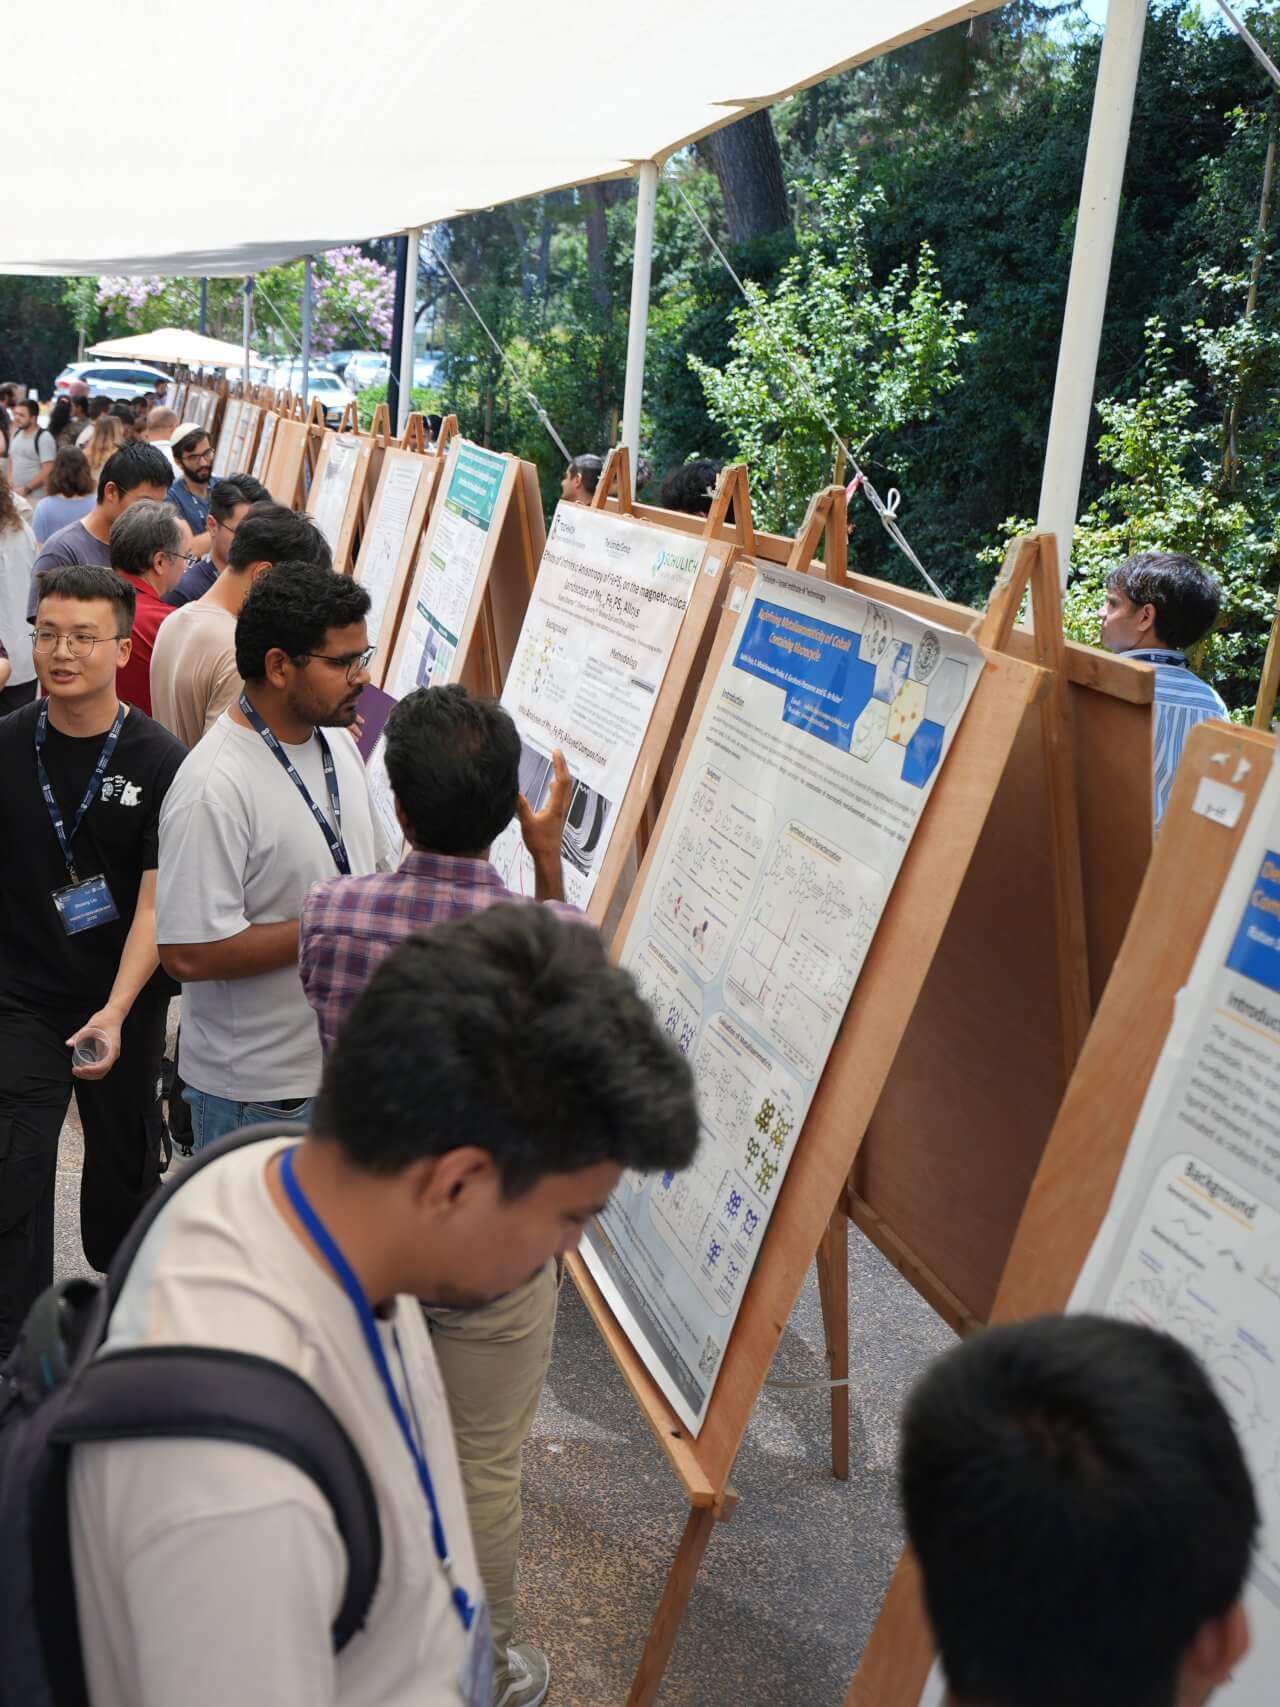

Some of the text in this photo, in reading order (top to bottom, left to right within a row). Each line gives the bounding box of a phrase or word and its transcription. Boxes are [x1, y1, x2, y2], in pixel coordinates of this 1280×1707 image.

[663, 551, 698, 574] SCHULICH
[630, 579, 640, 593] the
[623, 601, 641, 619] Alloys
[1183, 1159, 1258, 1221] Background
